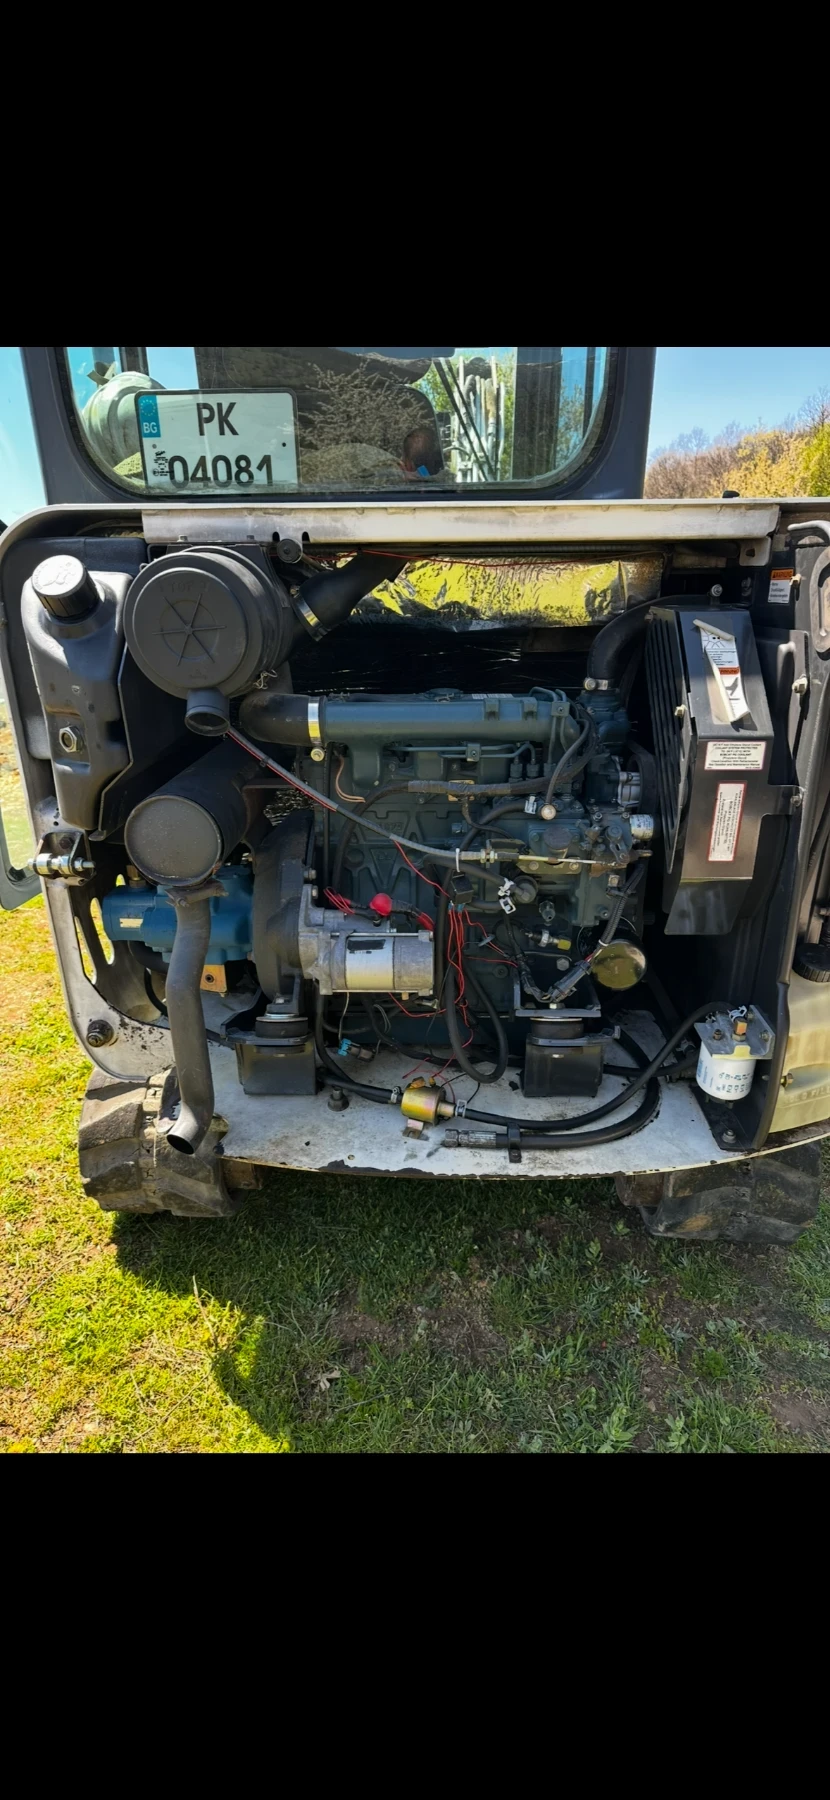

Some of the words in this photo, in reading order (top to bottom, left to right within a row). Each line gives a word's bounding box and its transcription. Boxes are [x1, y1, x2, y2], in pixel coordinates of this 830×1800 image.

[143, 422, 157, 433] BG
[196, 402, 239, 436] PK
[168, 454, 273, 488] 04081
